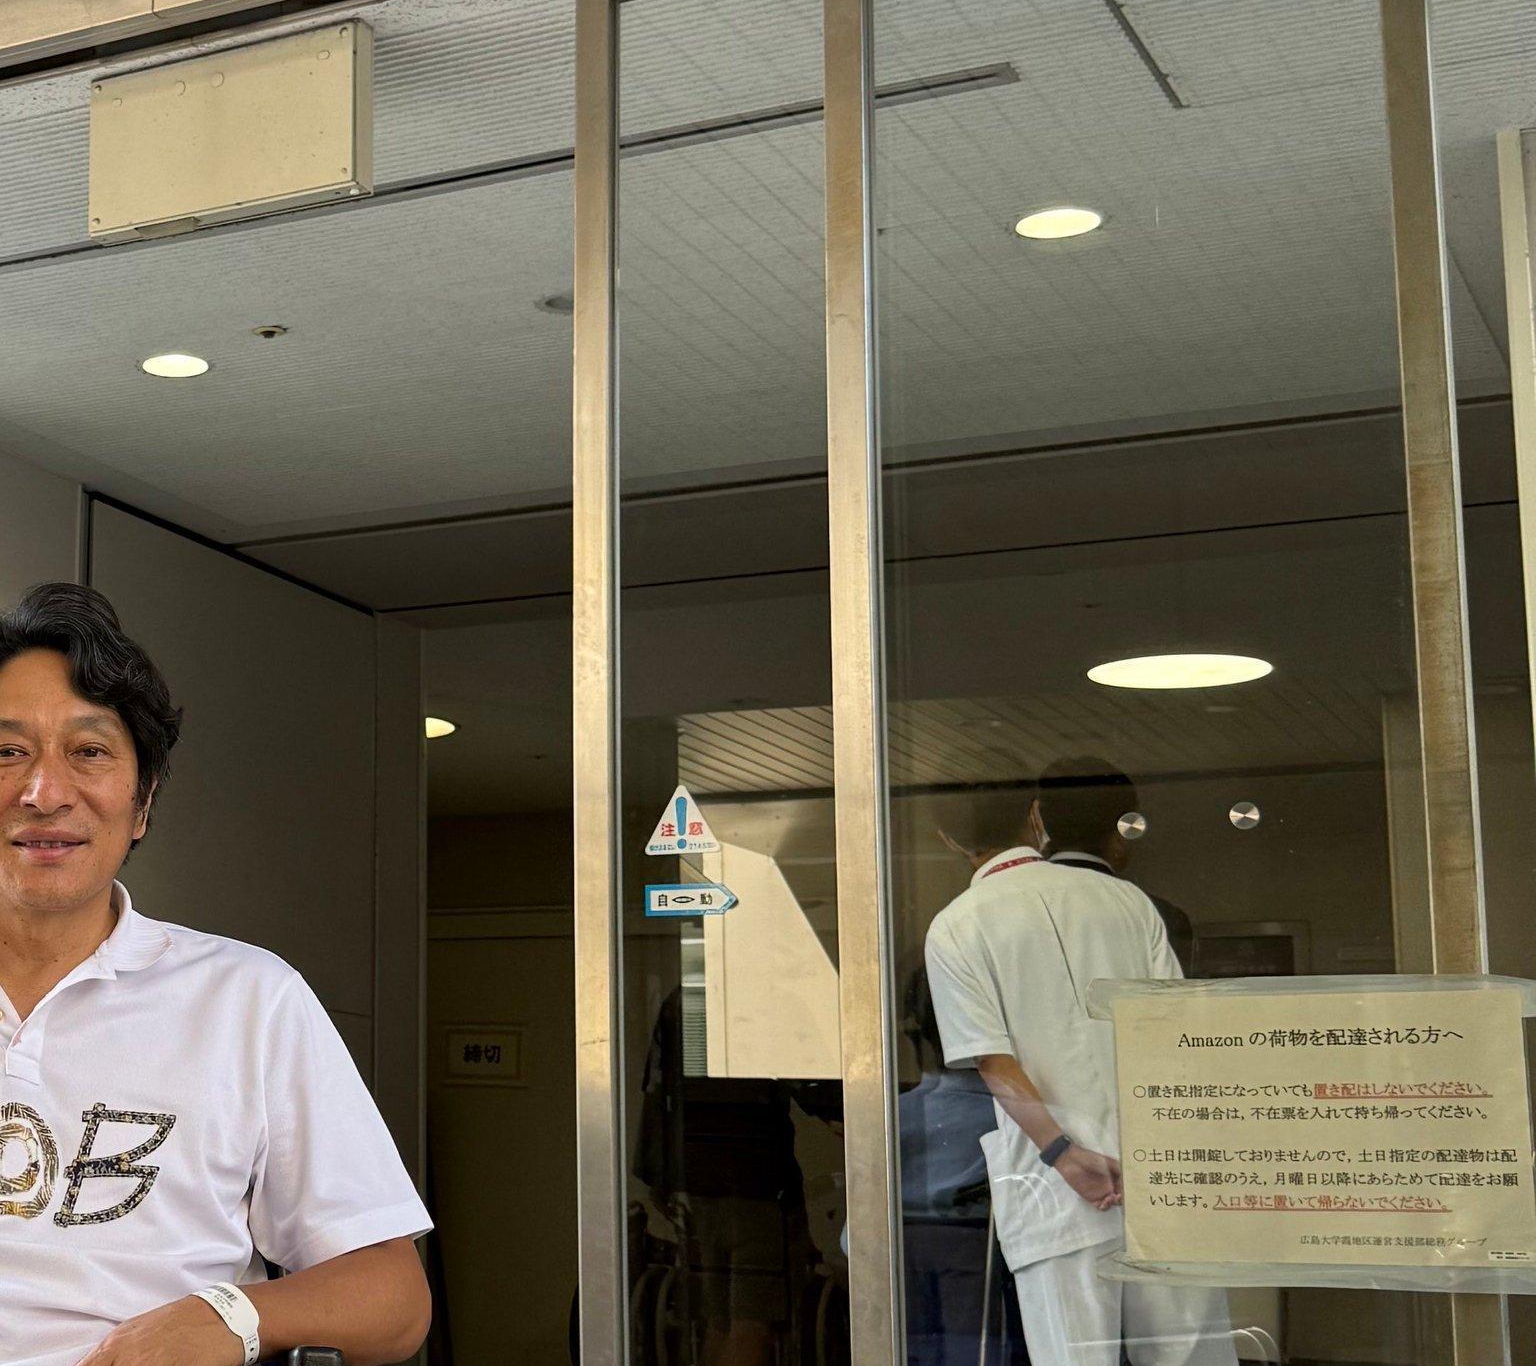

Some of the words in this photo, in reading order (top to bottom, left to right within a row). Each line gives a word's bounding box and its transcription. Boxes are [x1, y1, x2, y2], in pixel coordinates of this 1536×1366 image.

[1177, 1033, 1244, 1048] Amazon
[1248, 1025, 1465, 1047] の荷物を配達される方へ
